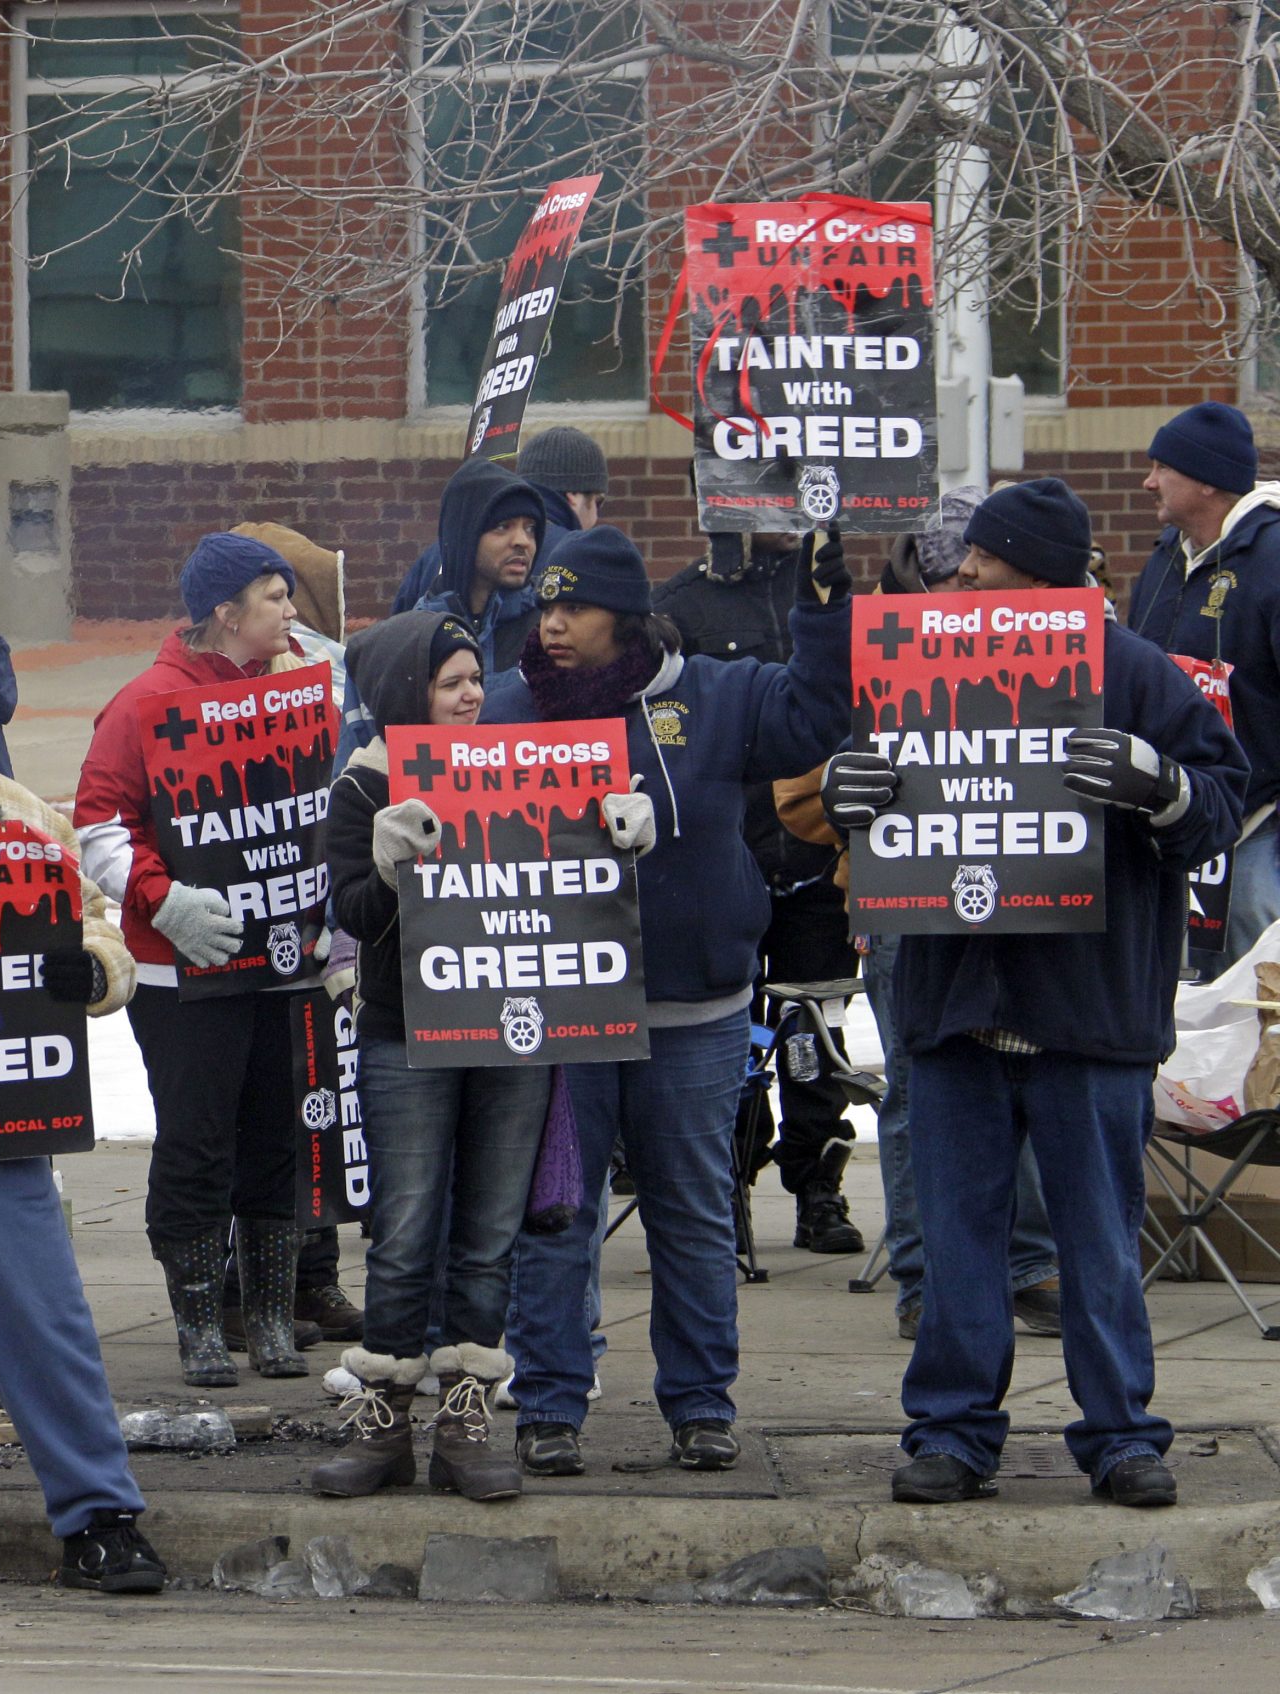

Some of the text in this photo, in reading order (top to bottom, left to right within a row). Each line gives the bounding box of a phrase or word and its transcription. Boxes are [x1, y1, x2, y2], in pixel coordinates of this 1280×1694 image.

[549, 192, 587, 214] Cross
[755, 218, 916, 243] Red Cross
[758, 246, 918, 266] UNFAIR
[496, 333, 518, 358] With
[713, 336, 920, 371] TAINTED
[782, 381, 852, 405] With
[713, 416, 923, 460] GREED
[706, 496, 929, 508] TEAMSTERS LOCAL 507
[922, 607, 1086, 634] Red Cross
[922, 633, 1086, 659] UNFAIR
[201, 683, 324, 723] Red Cross
[206, 703, 327, 746] UNFAIR
[451, 740, 609, 767] Red Cross
[453, 765, 612, 792] UNFAIR
[941, 777, 1014, 802] With
[171, 787, 331, 847] TAINTED
[870, 811, 1088, 858] GREED
[242, 841, 301, 872] With
[207, 862, 329, 921] REED
[414, 858, 620, 899] TAINTED
[857, 895, 1093, 909] TEAMSTERS LOCAL 507
[481, 908, 551, 935] With
[419, 941, 627, 991] GREED
[414, 1023, 638, 1042] TEAMSTERS LOCAL 507
[304, 1002, 322, 1218] TEAMSTERS LOCAL 507
[334, 1005, 370, 1207] GREED
[51, 1116, 84, 1129] 507
